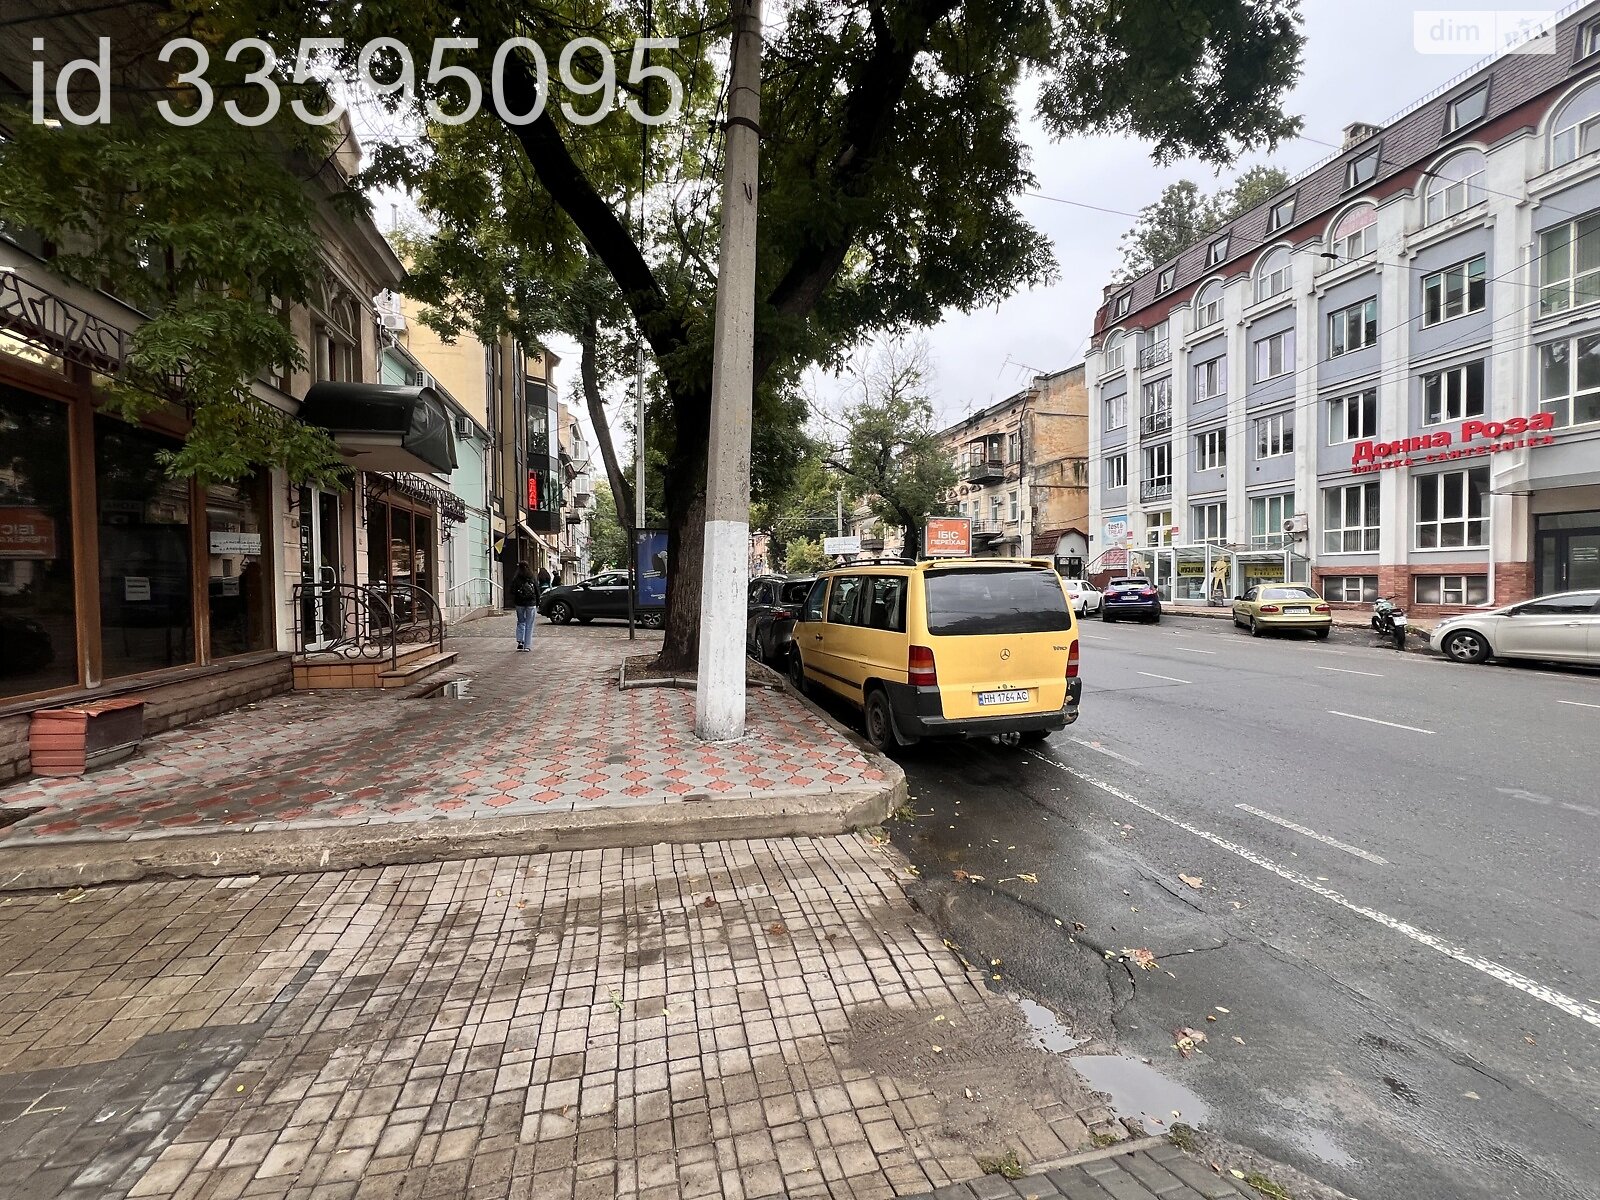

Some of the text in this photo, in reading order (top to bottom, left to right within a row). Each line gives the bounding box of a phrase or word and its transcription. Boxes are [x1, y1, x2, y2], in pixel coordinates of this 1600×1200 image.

[1352, 412, 1554, 465] Донна Роза
[937, 531, 959, 539] ІБІС
[984, 693, 996, 703] HH
[997, 692, 1015, 702] 1764
